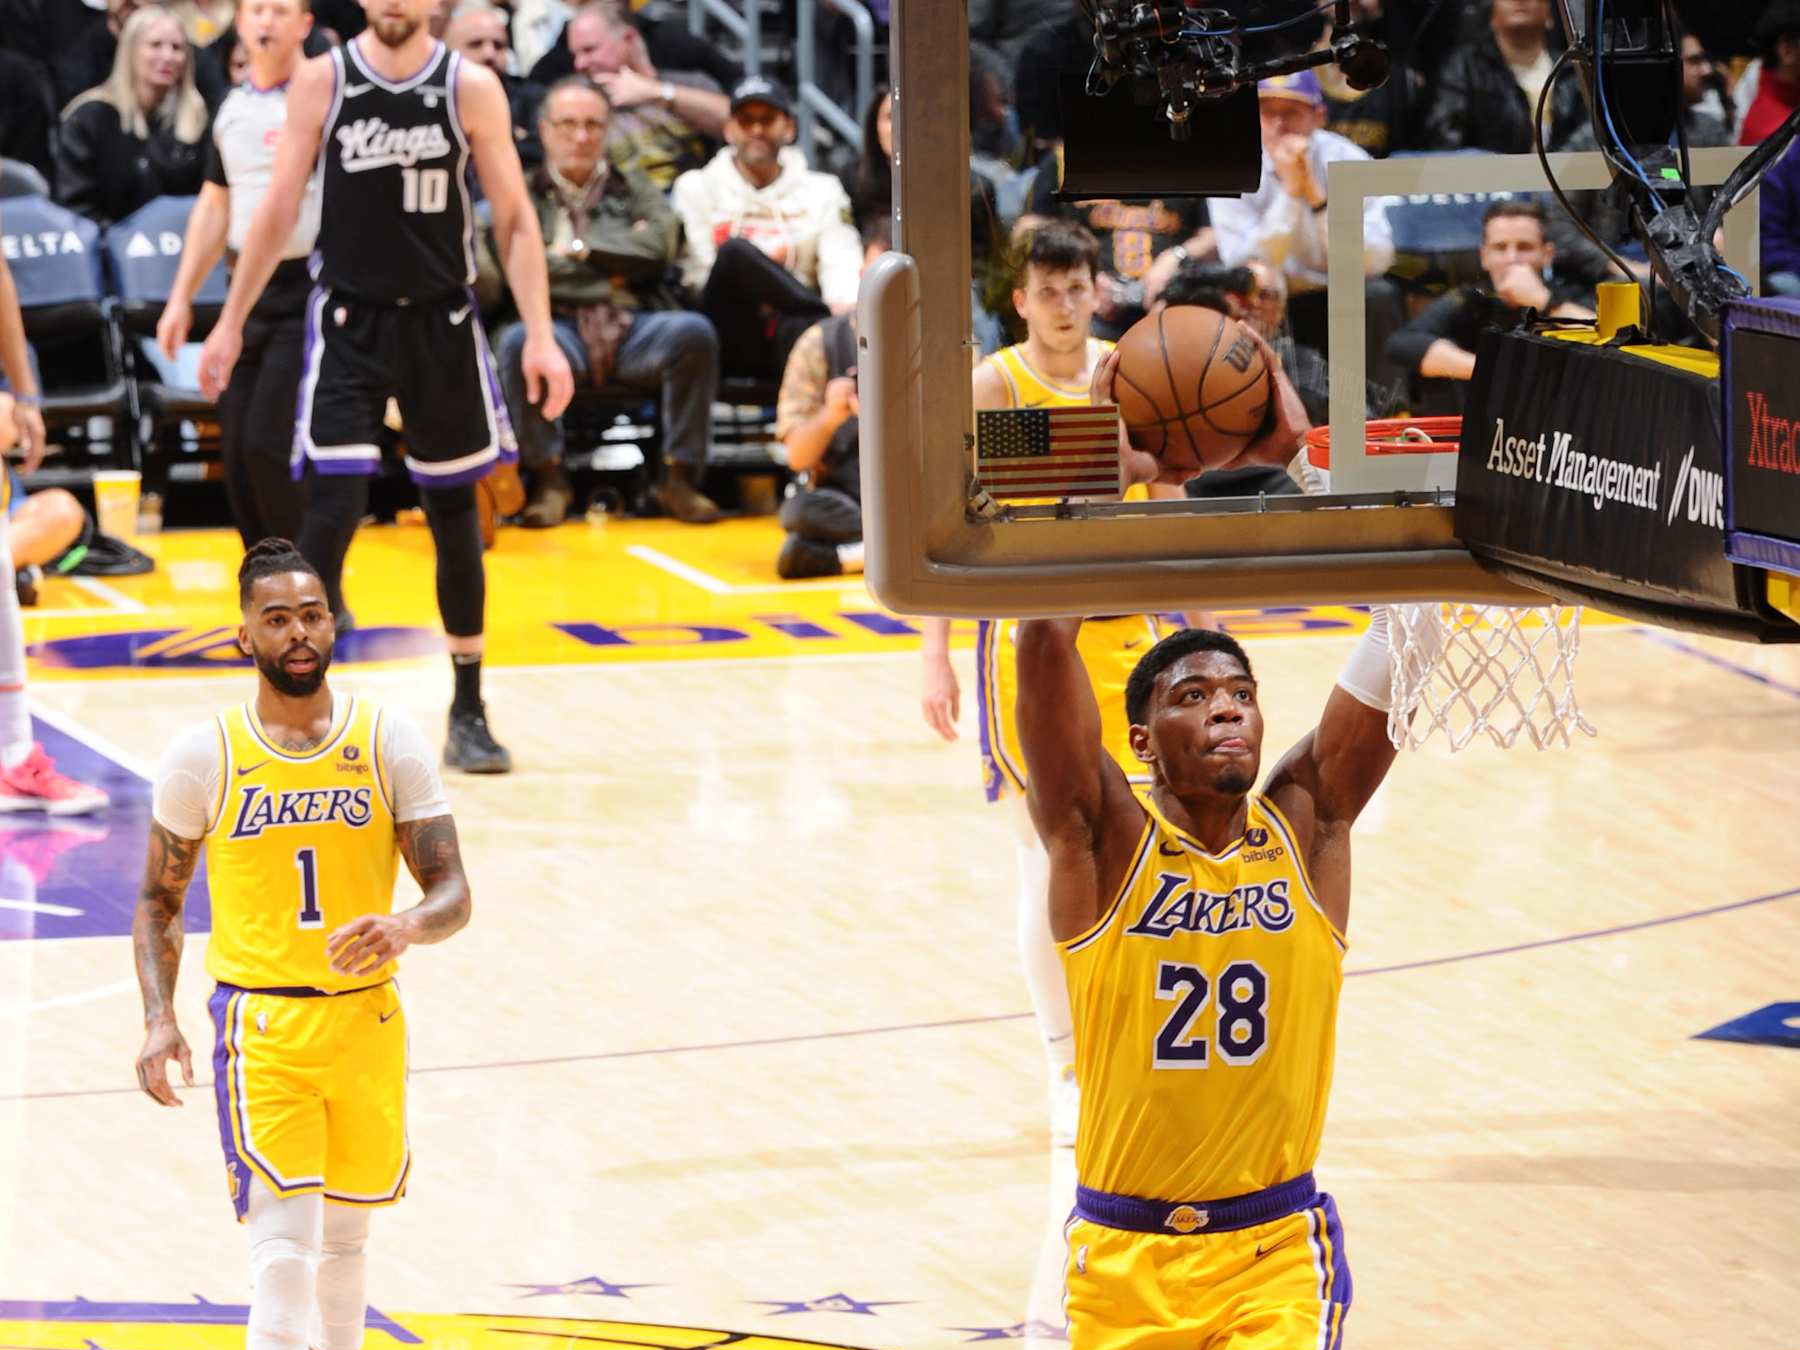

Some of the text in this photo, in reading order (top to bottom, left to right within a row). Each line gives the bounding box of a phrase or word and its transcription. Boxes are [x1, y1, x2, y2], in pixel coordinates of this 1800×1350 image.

[336, 117, 451, 173] Kings
[401, 167, 449, 213] 10
[1113, 229, 1153, 278] 8
[1487, 417, 1546, 483] Asset
[1546, 430, 1661, 511] Management
[229, 785, 373, 840] LAKERS
[1243, 846, 1284, 864] bibigo
[296, 848, 325, 930] 1
[1124, 871, 1295, 938] LAKERS
[1152, 960, 1269, 1069] 28
